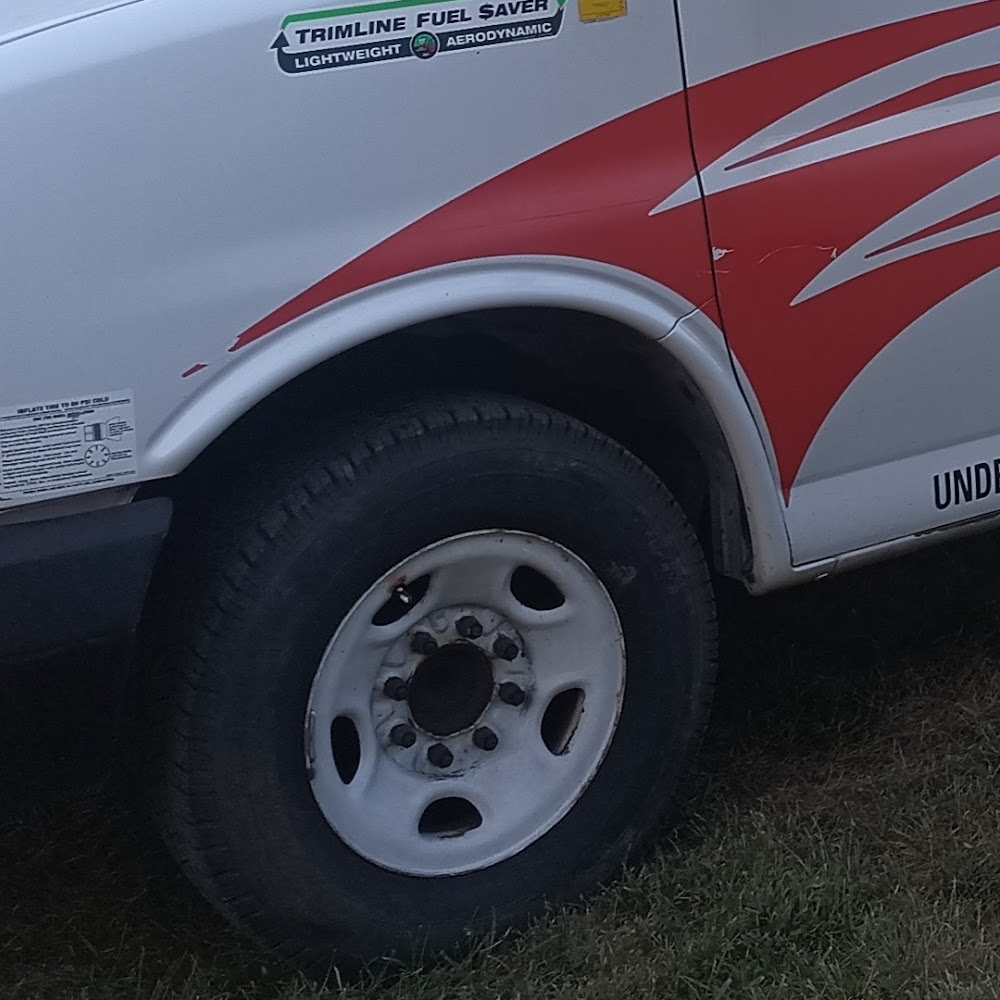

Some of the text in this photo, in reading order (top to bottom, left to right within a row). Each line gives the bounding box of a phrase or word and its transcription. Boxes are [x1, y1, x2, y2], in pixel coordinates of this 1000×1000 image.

[295, 17, 406, 45] TRIMLINE
[416, 8, 472, 28] FUEL
[446, 22, 553, 47] AERODYNAMIC
[294, 43, 402, 69] LIGHTWEIGHT
